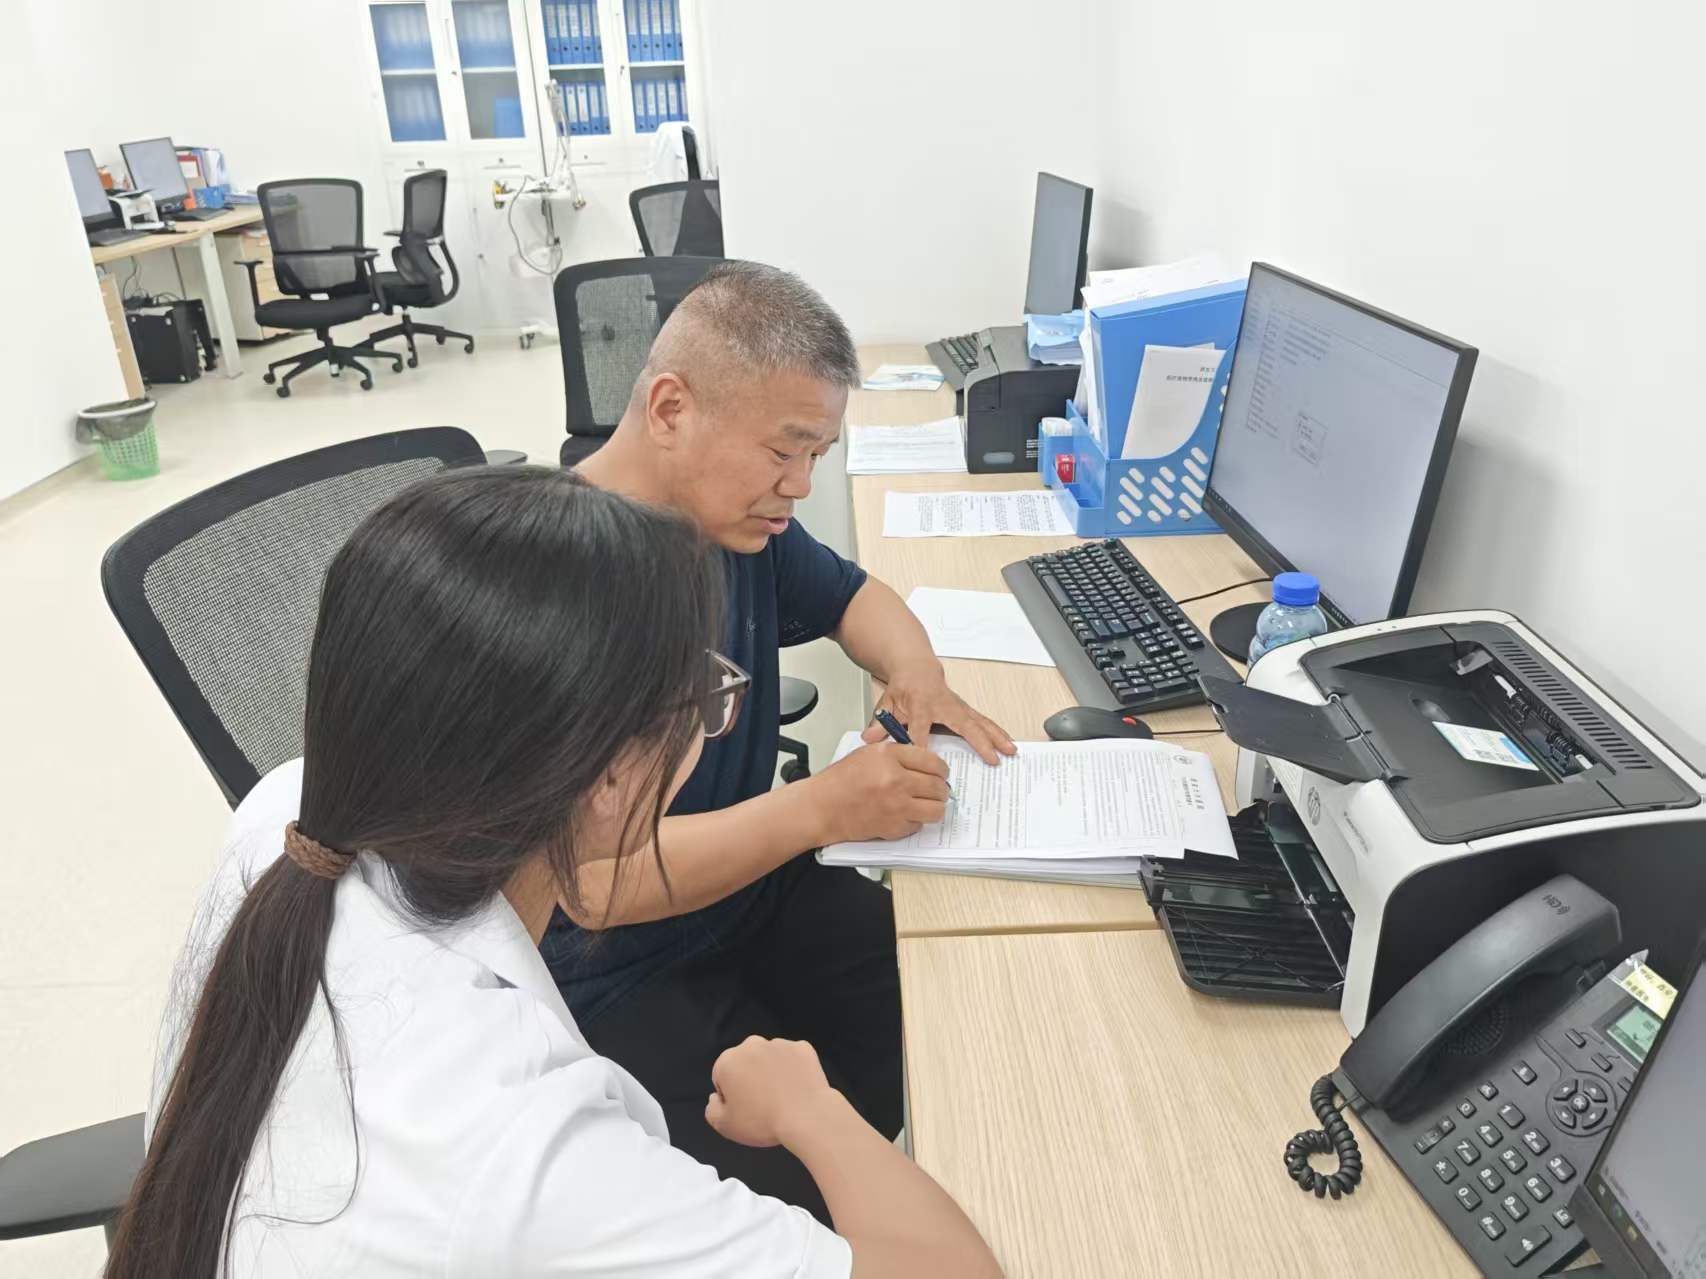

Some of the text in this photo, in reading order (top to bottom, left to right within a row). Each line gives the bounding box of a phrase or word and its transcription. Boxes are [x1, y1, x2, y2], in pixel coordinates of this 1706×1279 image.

[1501, 1105, 1511, 1115] 1
[1480, 1125, 1491, 1134] 4
[1524, 1131, 1537, 1141] 2
[1457, 1141, 1469, 1150] 7
[1503, 1150, 1515, 1160] 5
[1550, 1158, 1562, 1168] 3
[1480, 1168, 1492, 1178] 8
[1527, 1177, 1539, 1187] 6
[1458, 1187, 1469, 1196] 0
[1504, 1196, 1516, 1206] 9
